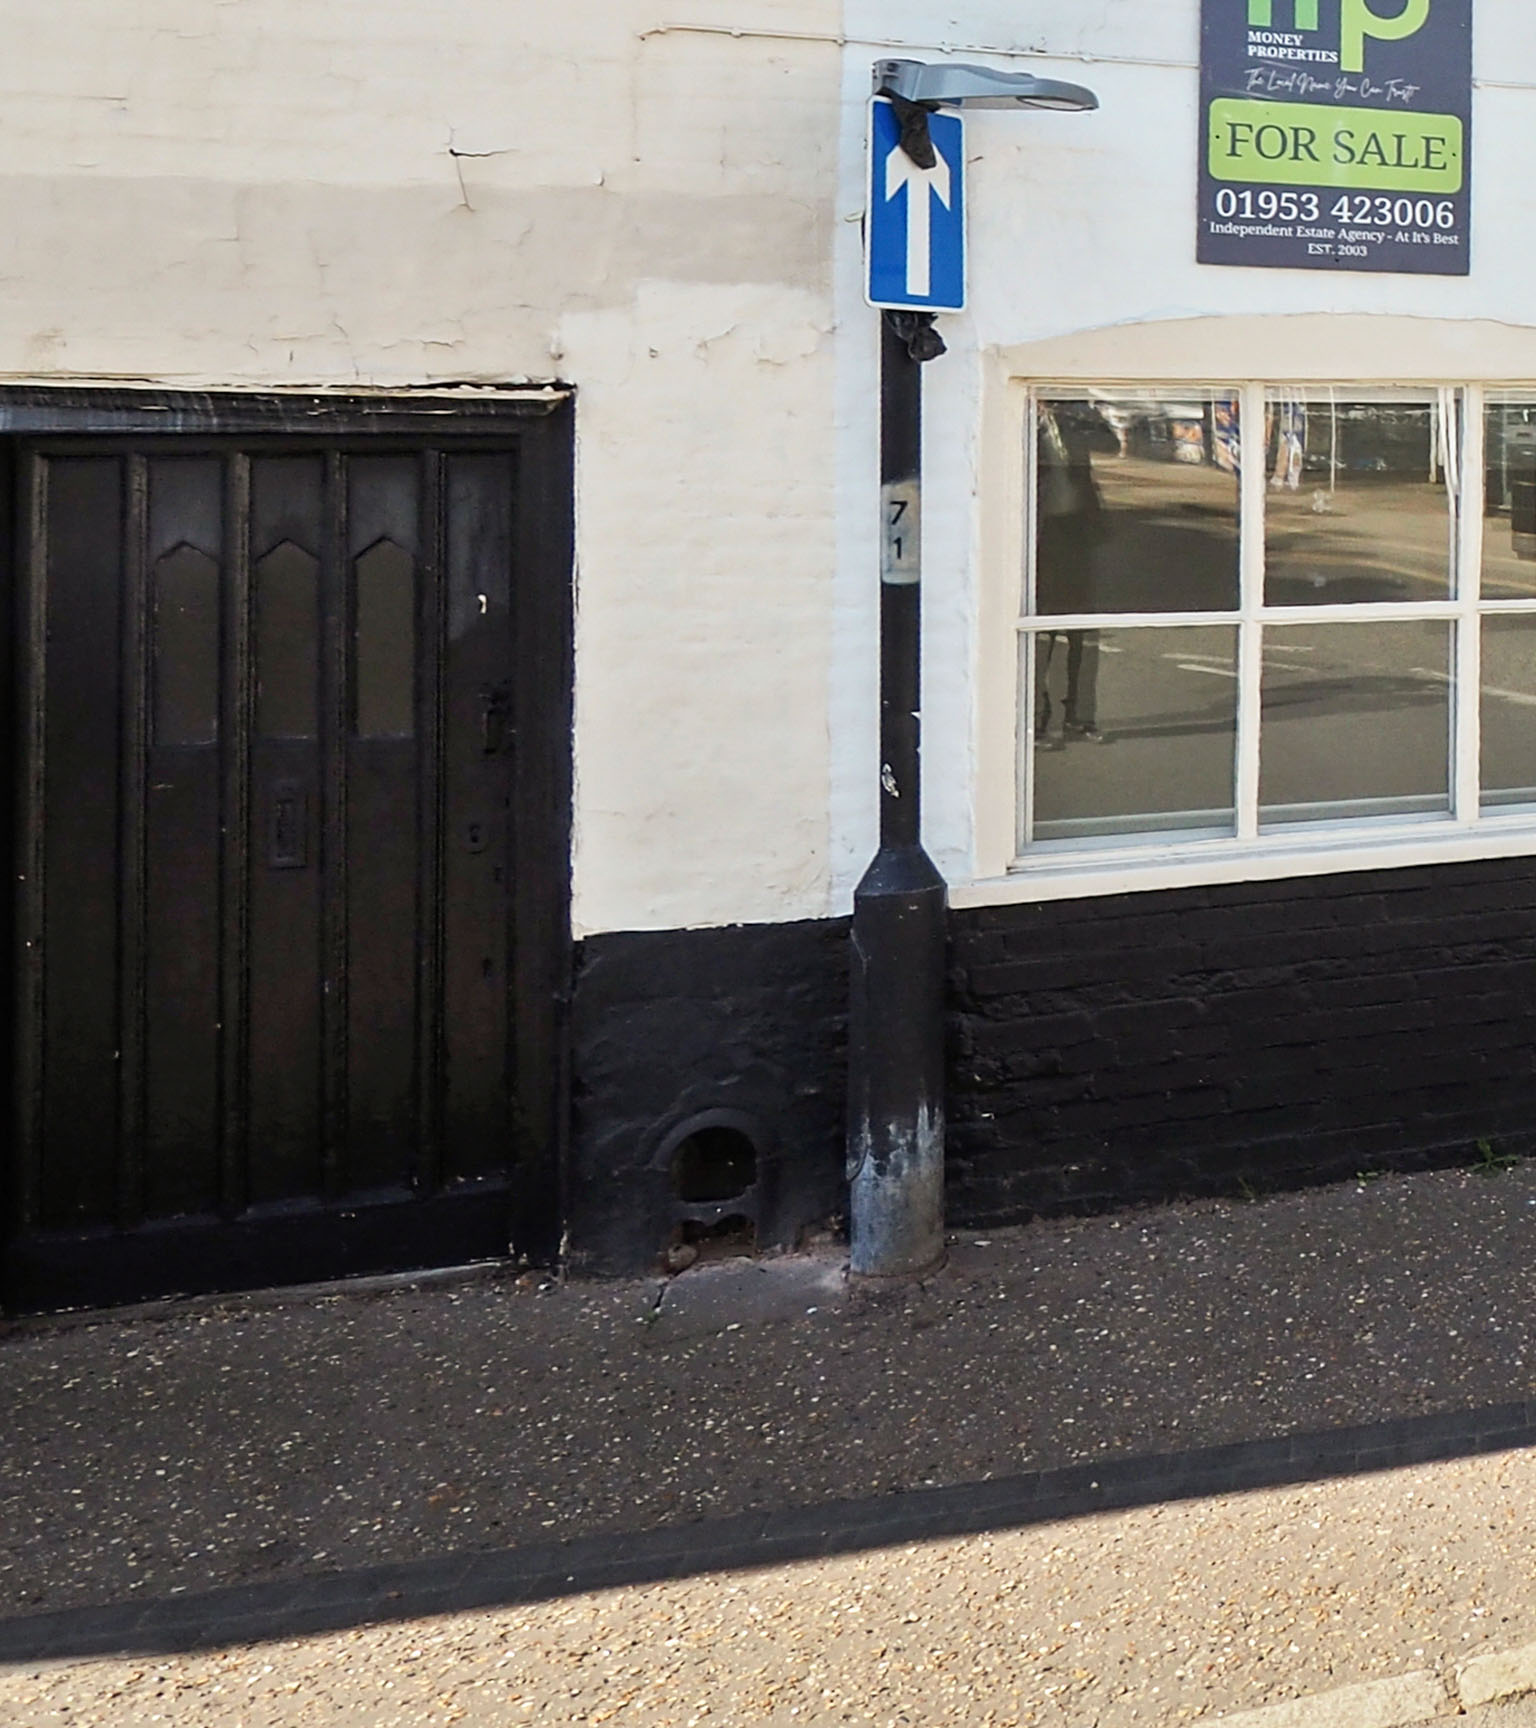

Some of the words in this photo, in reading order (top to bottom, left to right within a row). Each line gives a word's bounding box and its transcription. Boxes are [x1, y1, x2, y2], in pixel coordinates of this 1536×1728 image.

[1248, 31, 1303, 46] MONEY
[1248, 46, 1339, 63] PROPERTIES
[1225, 122, 1321, 162] FOR
[1332, 130, 1448, 171] SALE
[1214, 189, 1320, 221] 01953
[1331, 195, 1454, 228] 423006
[1210, 222, 1293, 239] Independent
[1296, 226, 1335, 239] Estate
[1338, 228, 1384, 244] Agency
[1395, 230, 1409, 242] At
[1433, 232, 1460, 246] Best
[1308, 243, 1335, 256] EST.
[1338, 244, 1368, 257] 2003
